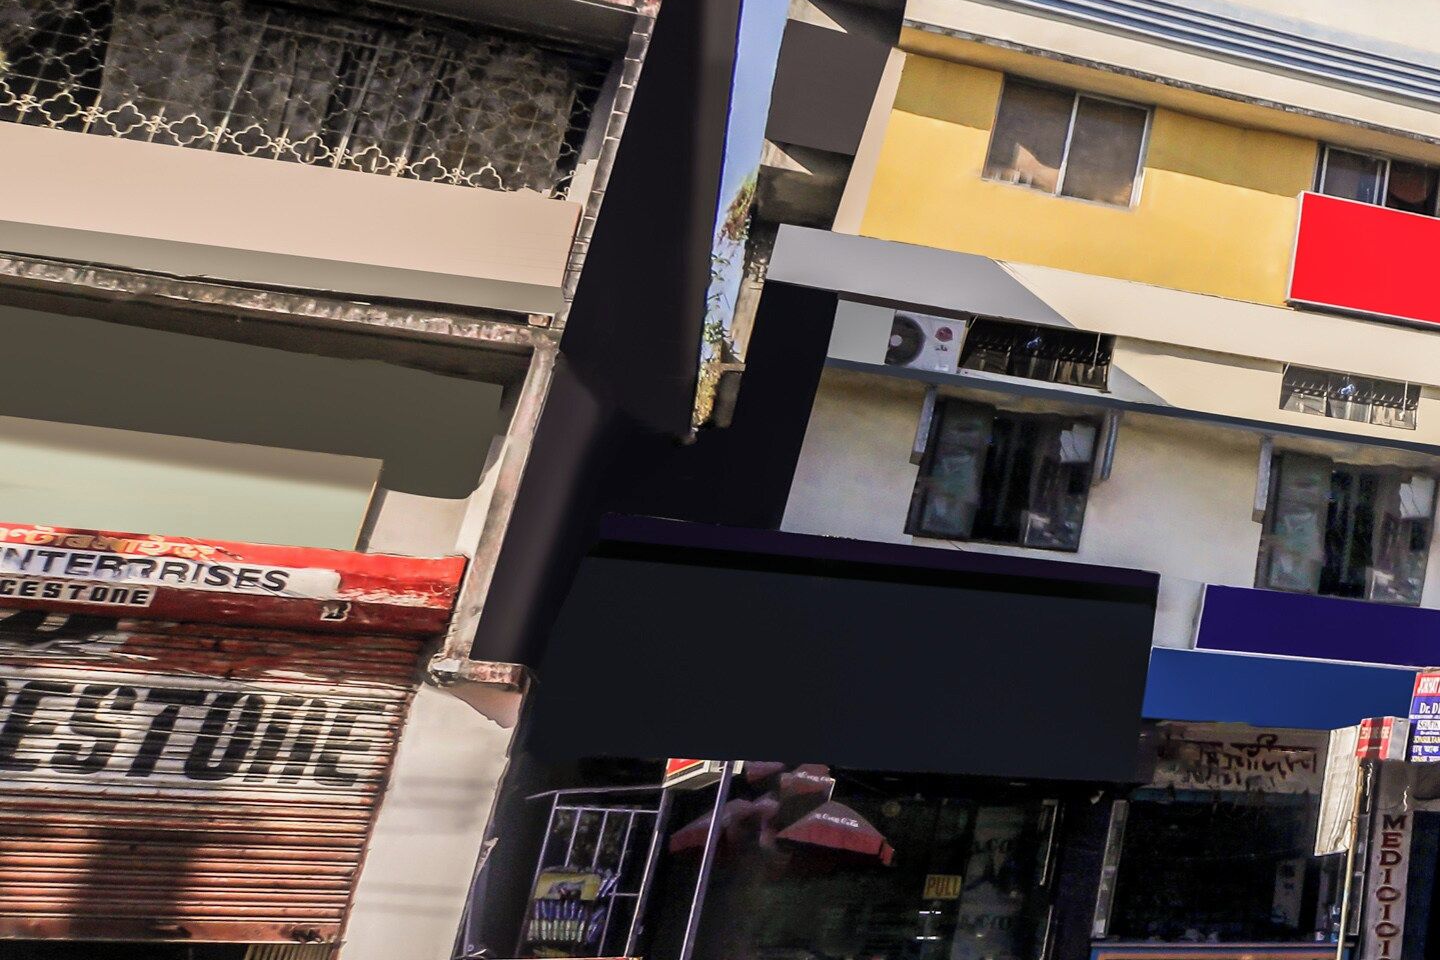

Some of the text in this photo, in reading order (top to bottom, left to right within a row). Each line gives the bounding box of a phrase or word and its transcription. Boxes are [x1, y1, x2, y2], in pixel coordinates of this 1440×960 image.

[0, 546, 290, 592] NTERPRISES
[1419, 702, 1430, 715] Dr.
[0, 678, 387, 788] ESTONE
[926, 877, 959, 896] PULL
[1375, 814, 1408, 960] MEDICICI
